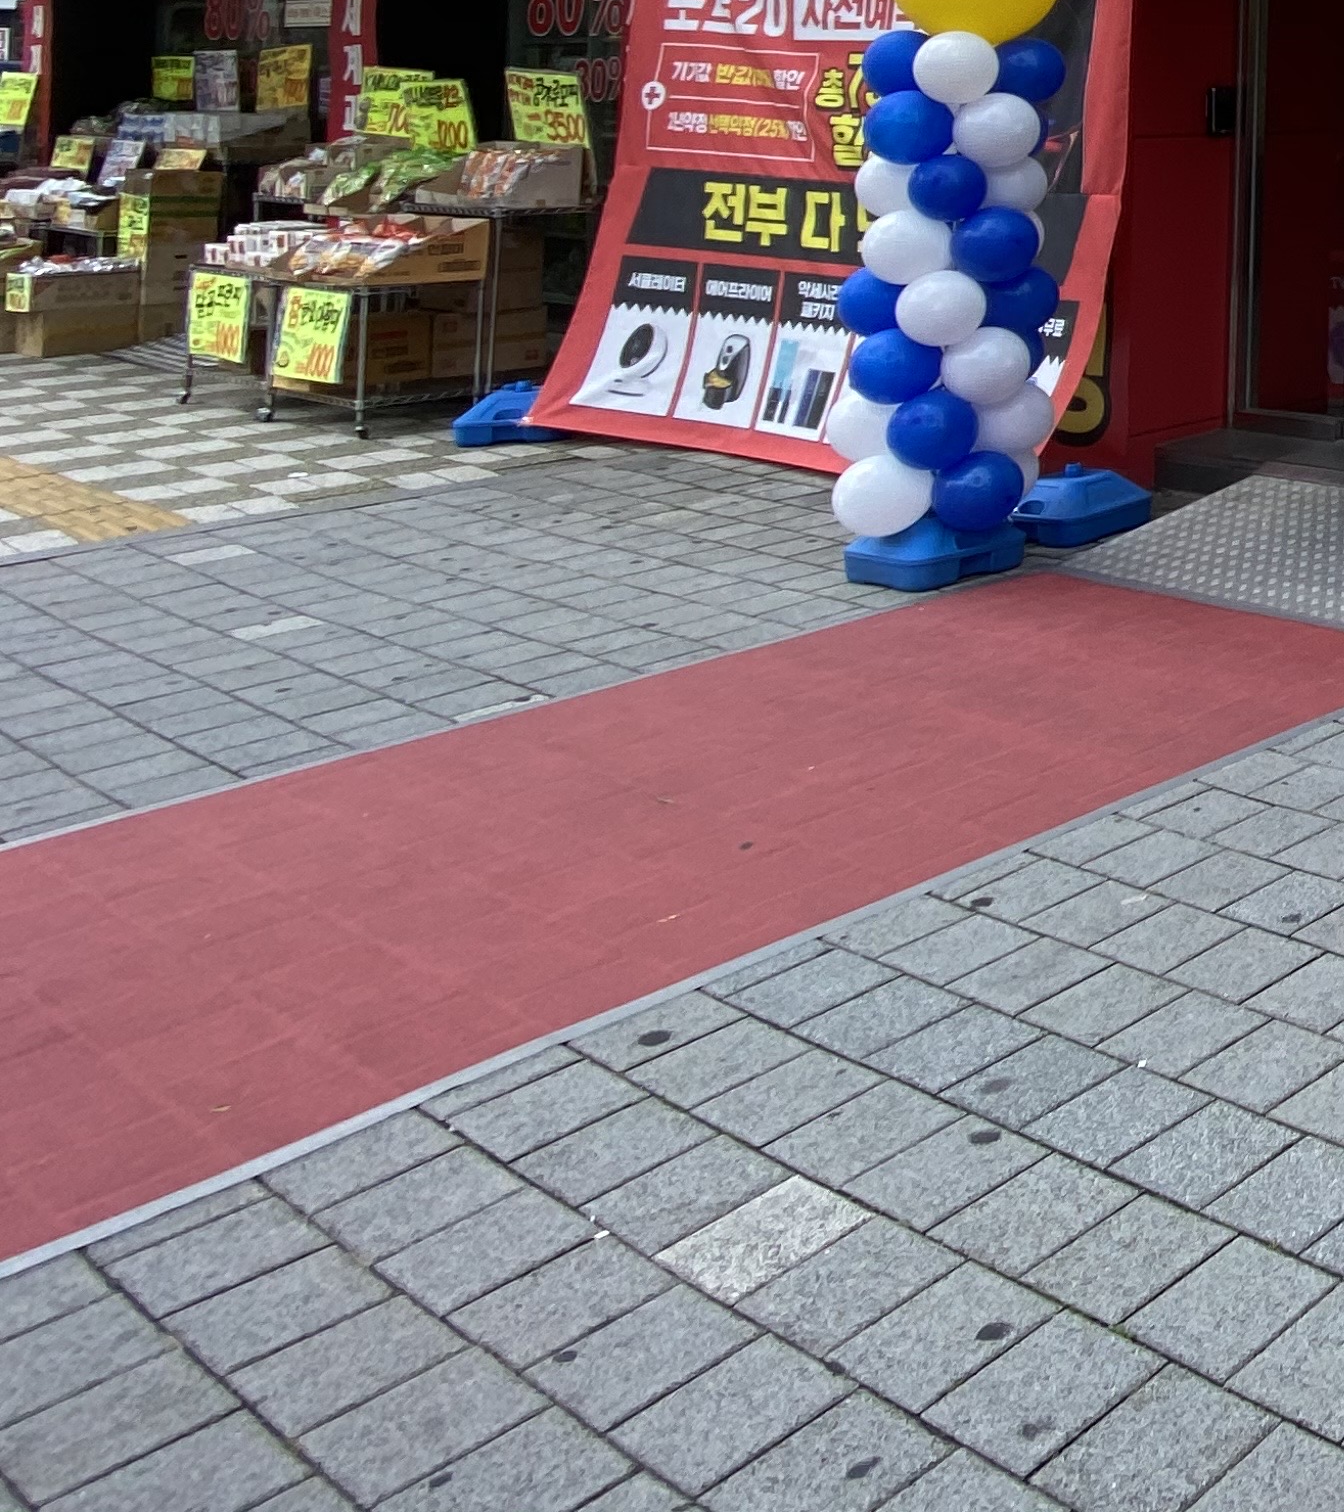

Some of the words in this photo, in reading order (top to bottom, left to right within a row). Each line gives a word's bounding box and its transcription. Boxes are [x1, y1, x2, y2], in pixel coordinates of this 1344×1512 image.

[773, 69, 806, 91] 할인
[702, 182, 788, 247] 전부
[803, 192, 846, 252] 다
